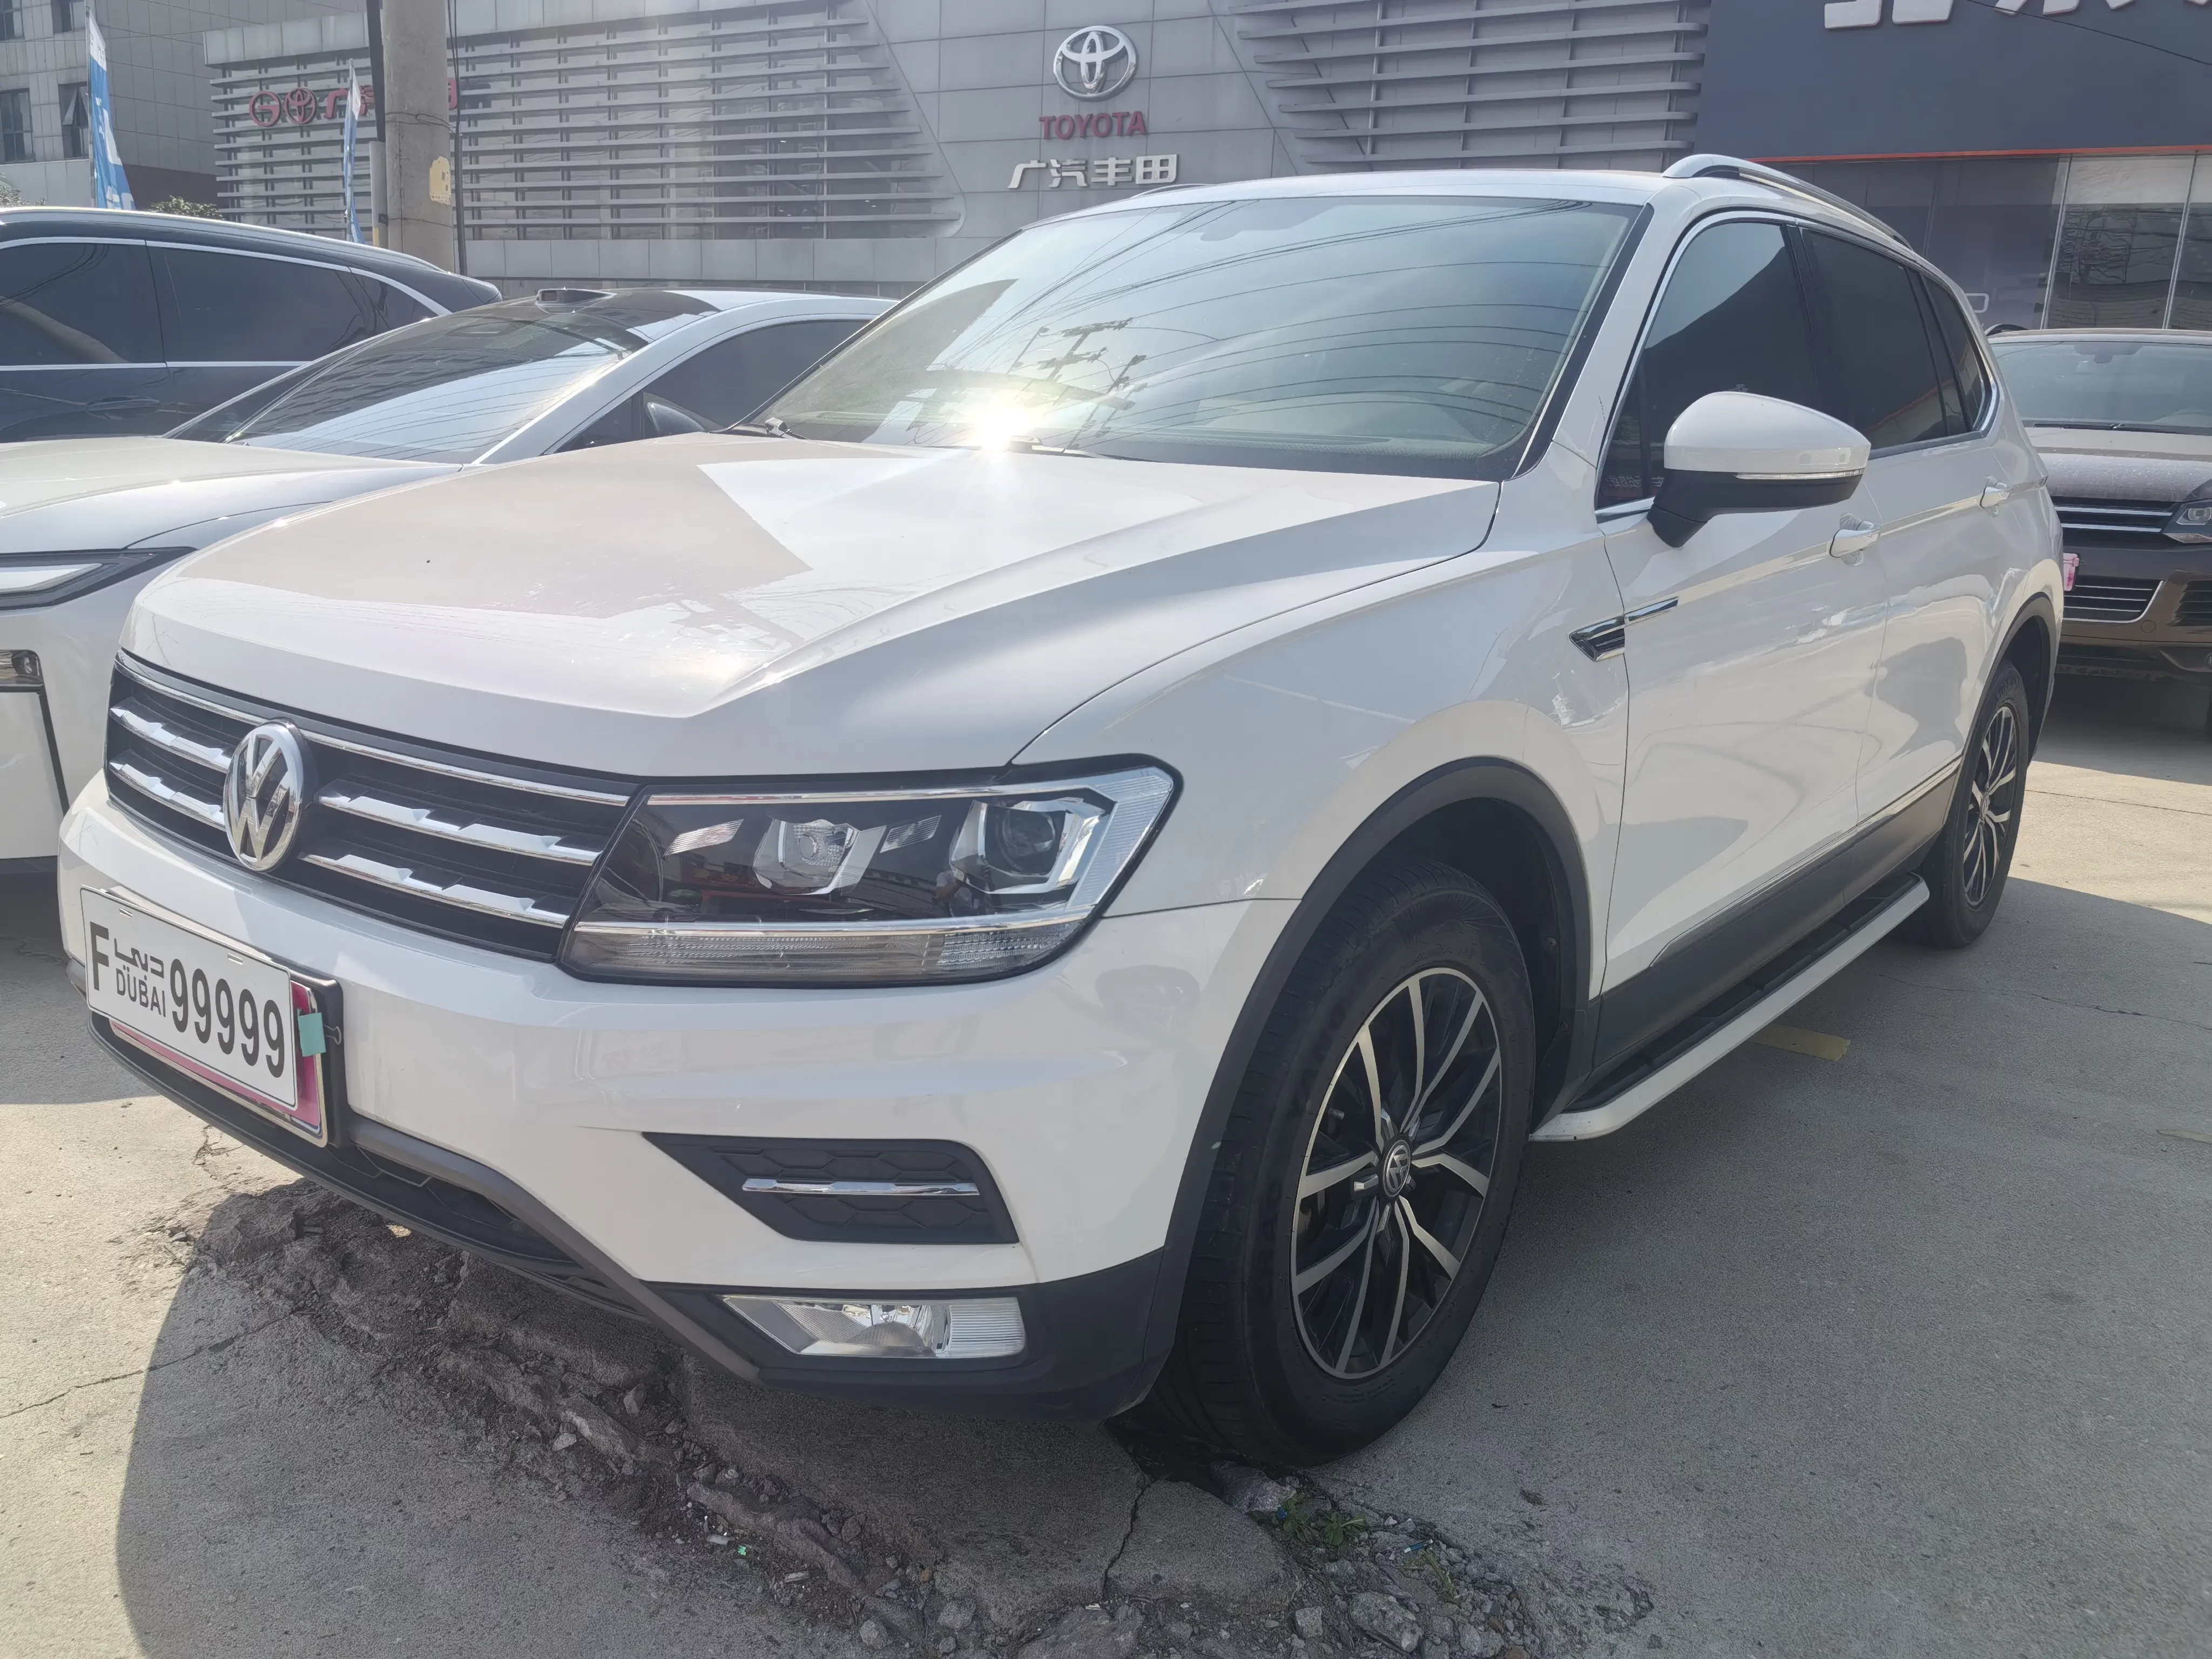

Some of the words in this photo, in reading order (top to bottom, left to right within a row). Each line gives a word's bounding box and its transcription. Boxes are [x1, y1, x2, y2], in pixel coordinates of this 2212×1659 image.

[1039, 111, 1148, 140] TOYOTA
[1007, 154, 1179, 189] 广汽丰田
[90, 921, 109, 991] F
[116, 968, 166, 1017] DUBAI
[170, 958, 285, 1078] 99999
